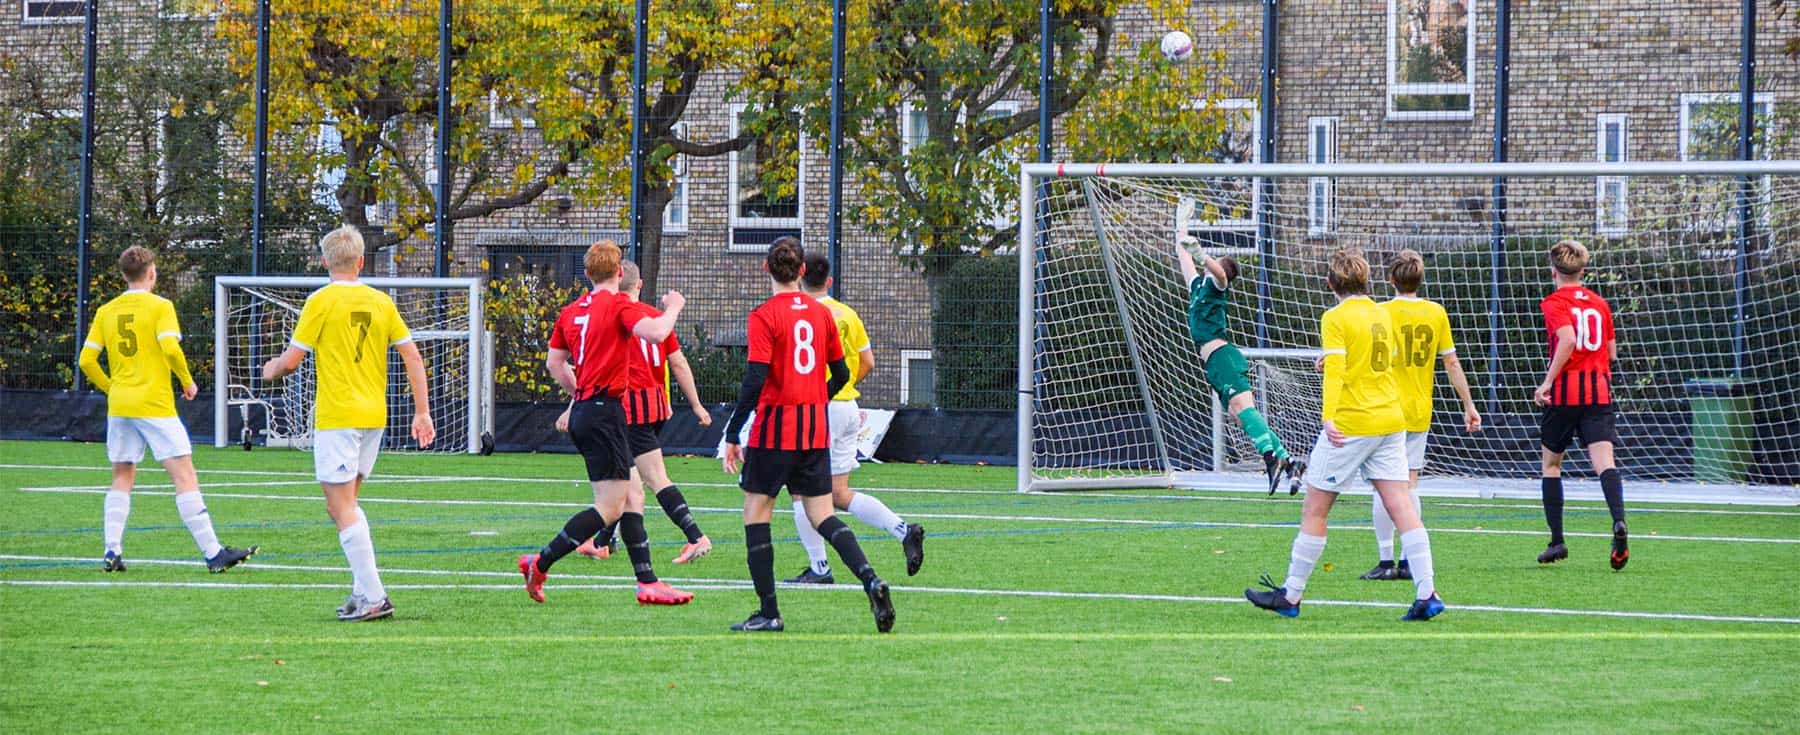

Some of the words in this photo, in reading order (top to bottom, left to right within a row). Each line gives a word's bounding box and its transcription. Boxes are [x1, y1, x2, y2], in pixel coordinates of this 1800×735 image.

[117, 314, 138, 357] 5
[350, 311, 371, 363] 7
[573, 313, 590, 366] 7
[793, 319, 816, 375] 8
[1371, 323, 1390, 372] 6
[1400, 323, 1433, 367] 13
[1570, 306, 1602, 351] 10
